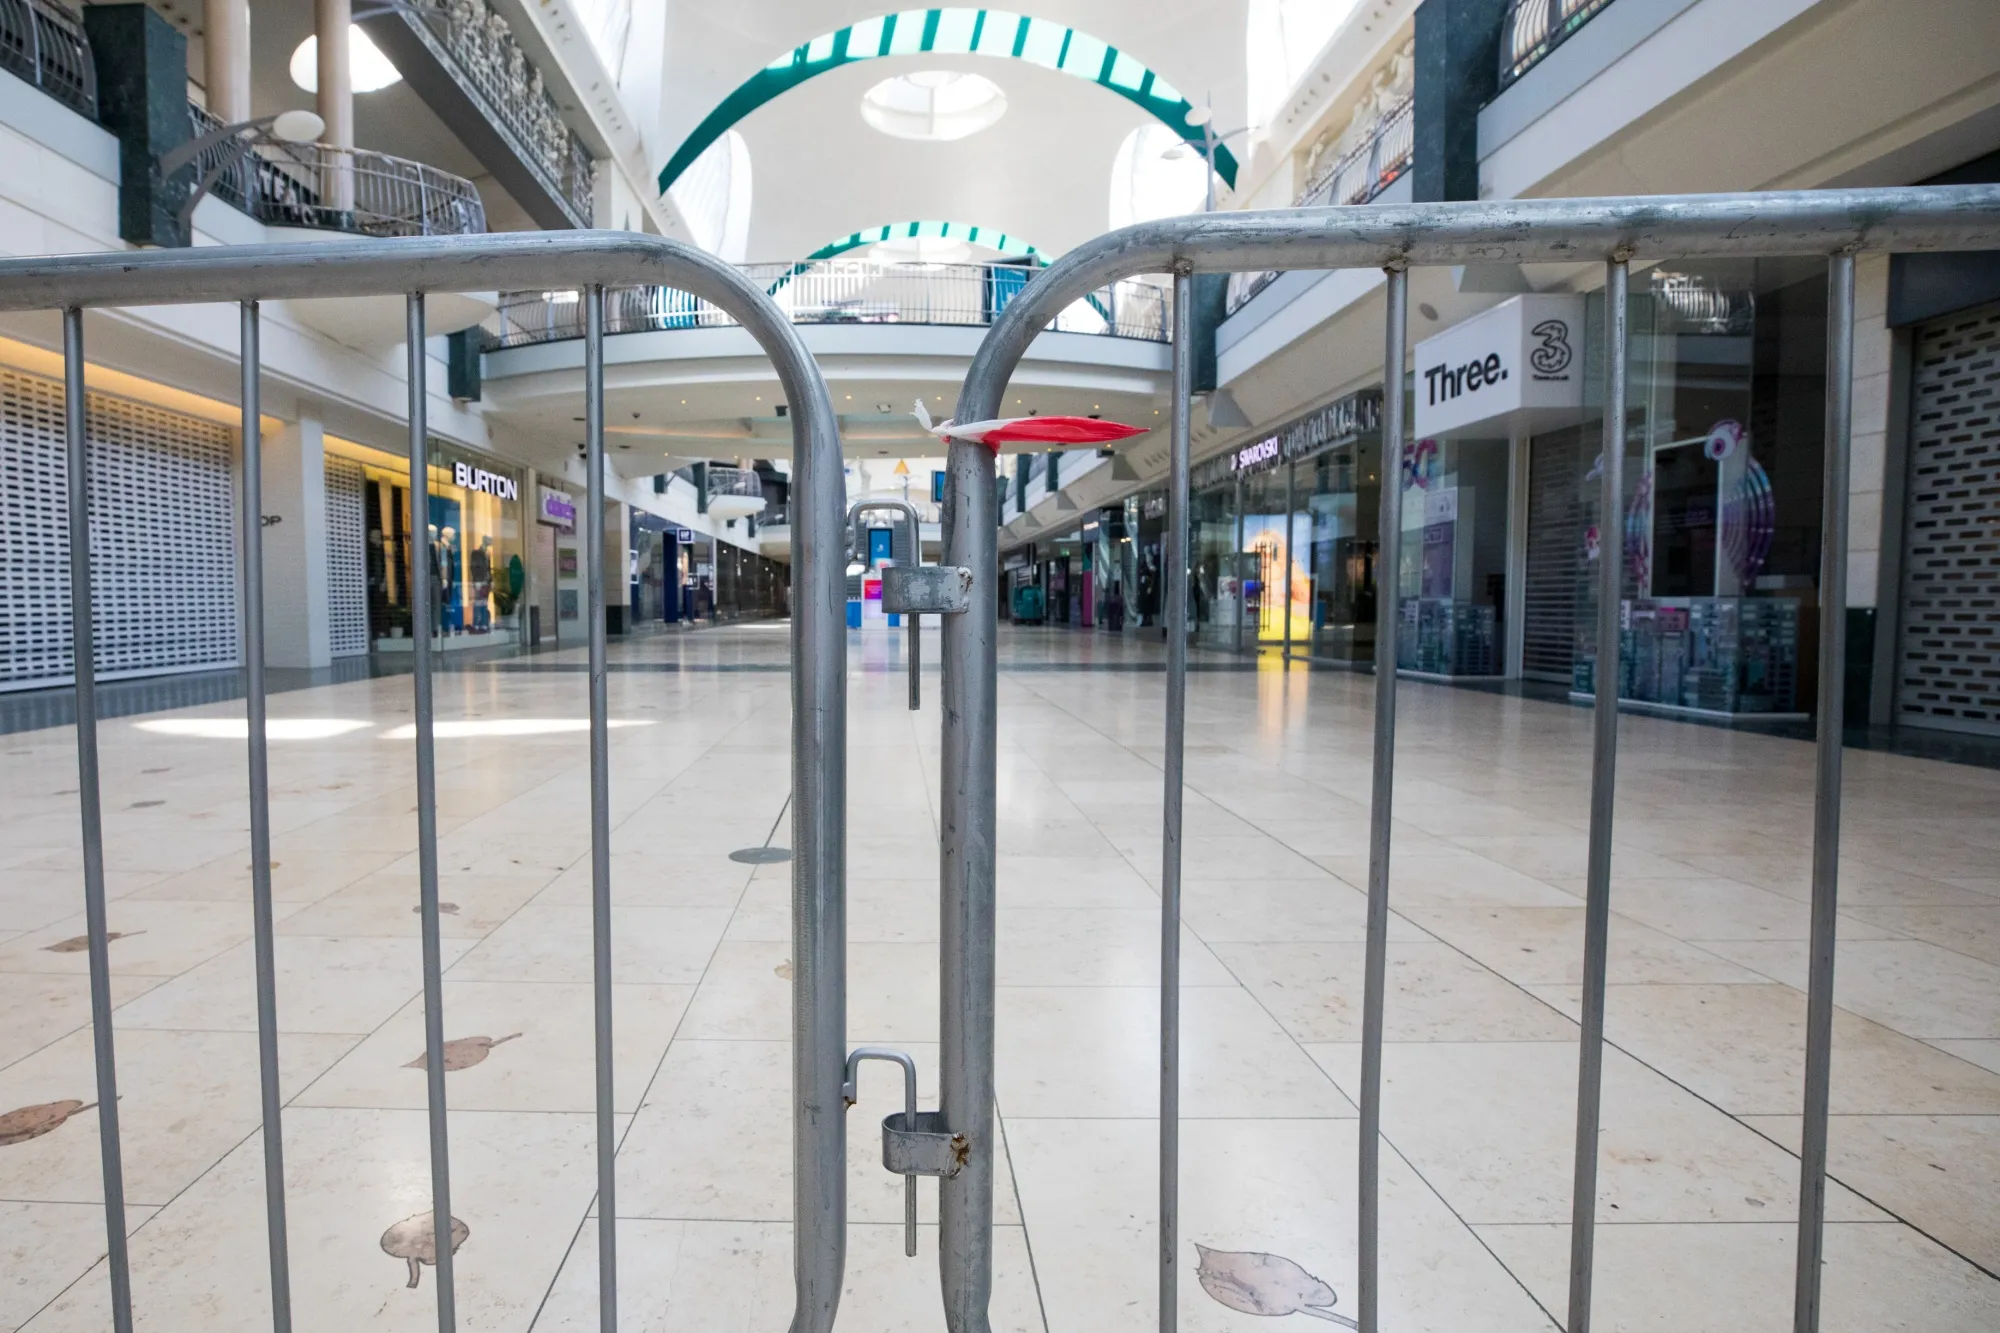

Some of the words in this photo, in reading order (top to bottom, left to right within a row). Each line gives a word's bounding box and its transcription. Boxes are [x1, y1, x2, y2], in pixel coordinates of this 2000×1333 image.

[1531, 319, 1572, 374] 3
[1424, 353, 1508, 406] Three.
[455, 461, 517, 501] BURTON
[261, 514, 282, 527] OP
